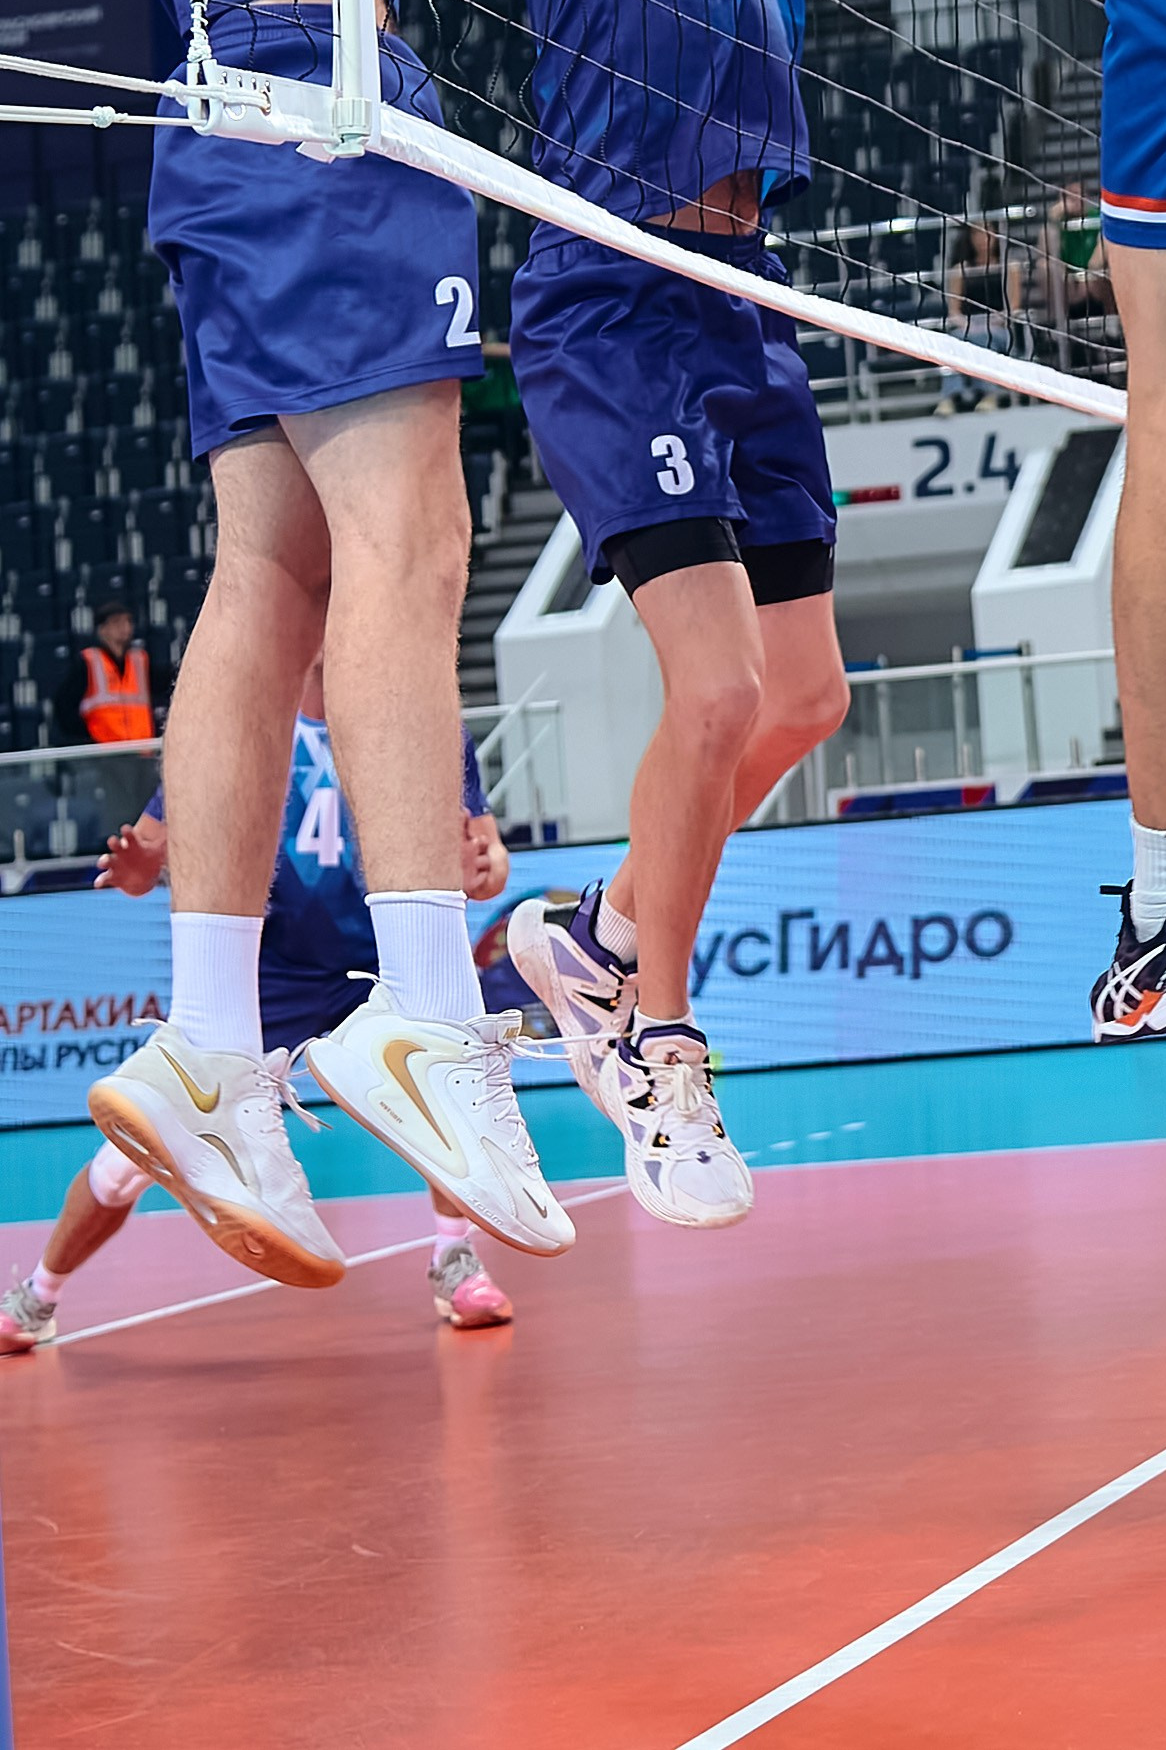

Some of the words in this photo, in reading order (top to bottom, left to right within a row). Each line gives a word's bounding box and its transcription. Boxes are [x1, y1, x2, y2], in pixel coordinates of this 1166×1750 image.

[435, 276, 481, 348] 2
[651, 435, 695, 495] 3
[912, 431, 1022, 497] 2.4
[295, 787, 344, 868] 4
